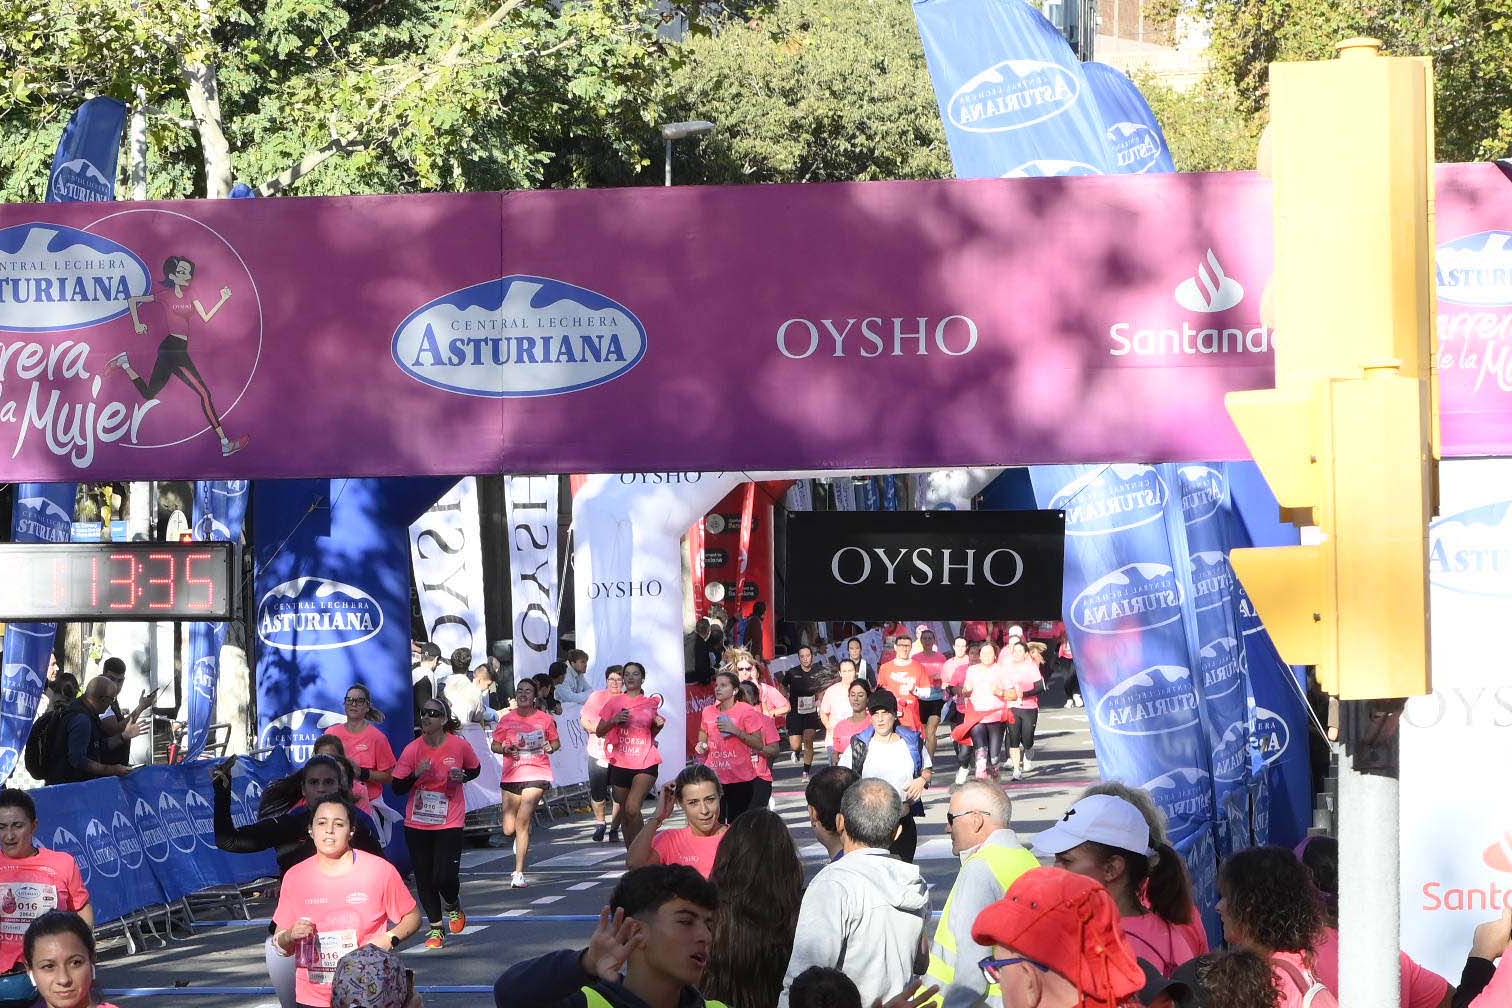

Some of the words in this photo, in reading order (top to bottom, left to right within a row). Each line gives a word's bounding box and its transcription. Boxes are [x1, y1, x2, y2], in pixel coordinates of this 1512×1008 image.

[53, 259, 127, 271] LECHERA
[451, 318, 528, 331] CENTRAL
[534, 316, 619, 329] LECHERA
[411, 321, 626, 366] ASTURIANA
[777, 315, 979, 359] OYSHO
[11, 370, 160, 469] Mujer
[832, 546, 1024, 587] OYSHO
[588, 580, 663, 600] OYSHO
[274, 601, 314, 611] CENTRAL
[320, 600, 369, 610] LECHERA
[259, 608, 374, 633] ASTURIANA
